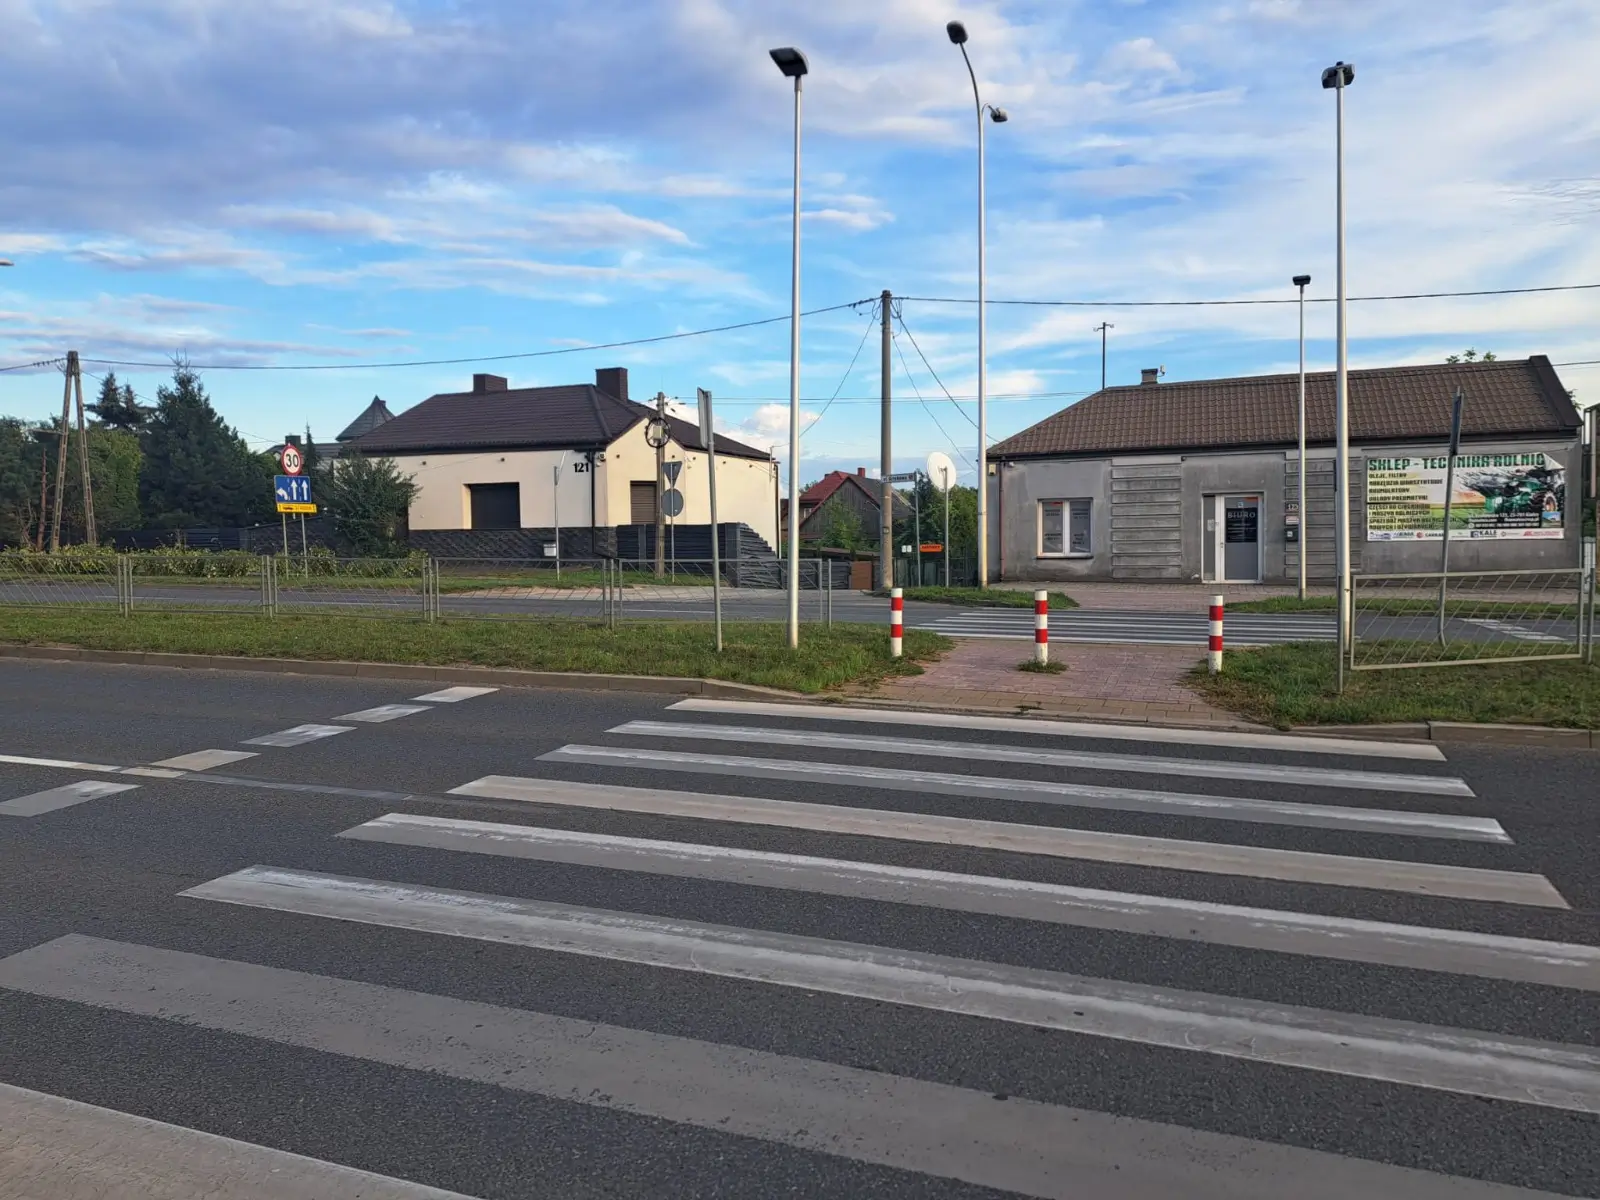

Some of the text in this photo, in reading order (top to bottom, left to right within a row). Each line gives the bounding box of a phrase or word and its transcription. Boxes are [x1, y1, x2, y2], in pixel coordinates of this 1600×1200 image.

[286, 454, 299, 468] 30
[573, 462, 589, 473] 121
[1369, 459, 1411, 471] SKLEP
[1422, 455, 1490, 470] TECNIKA
